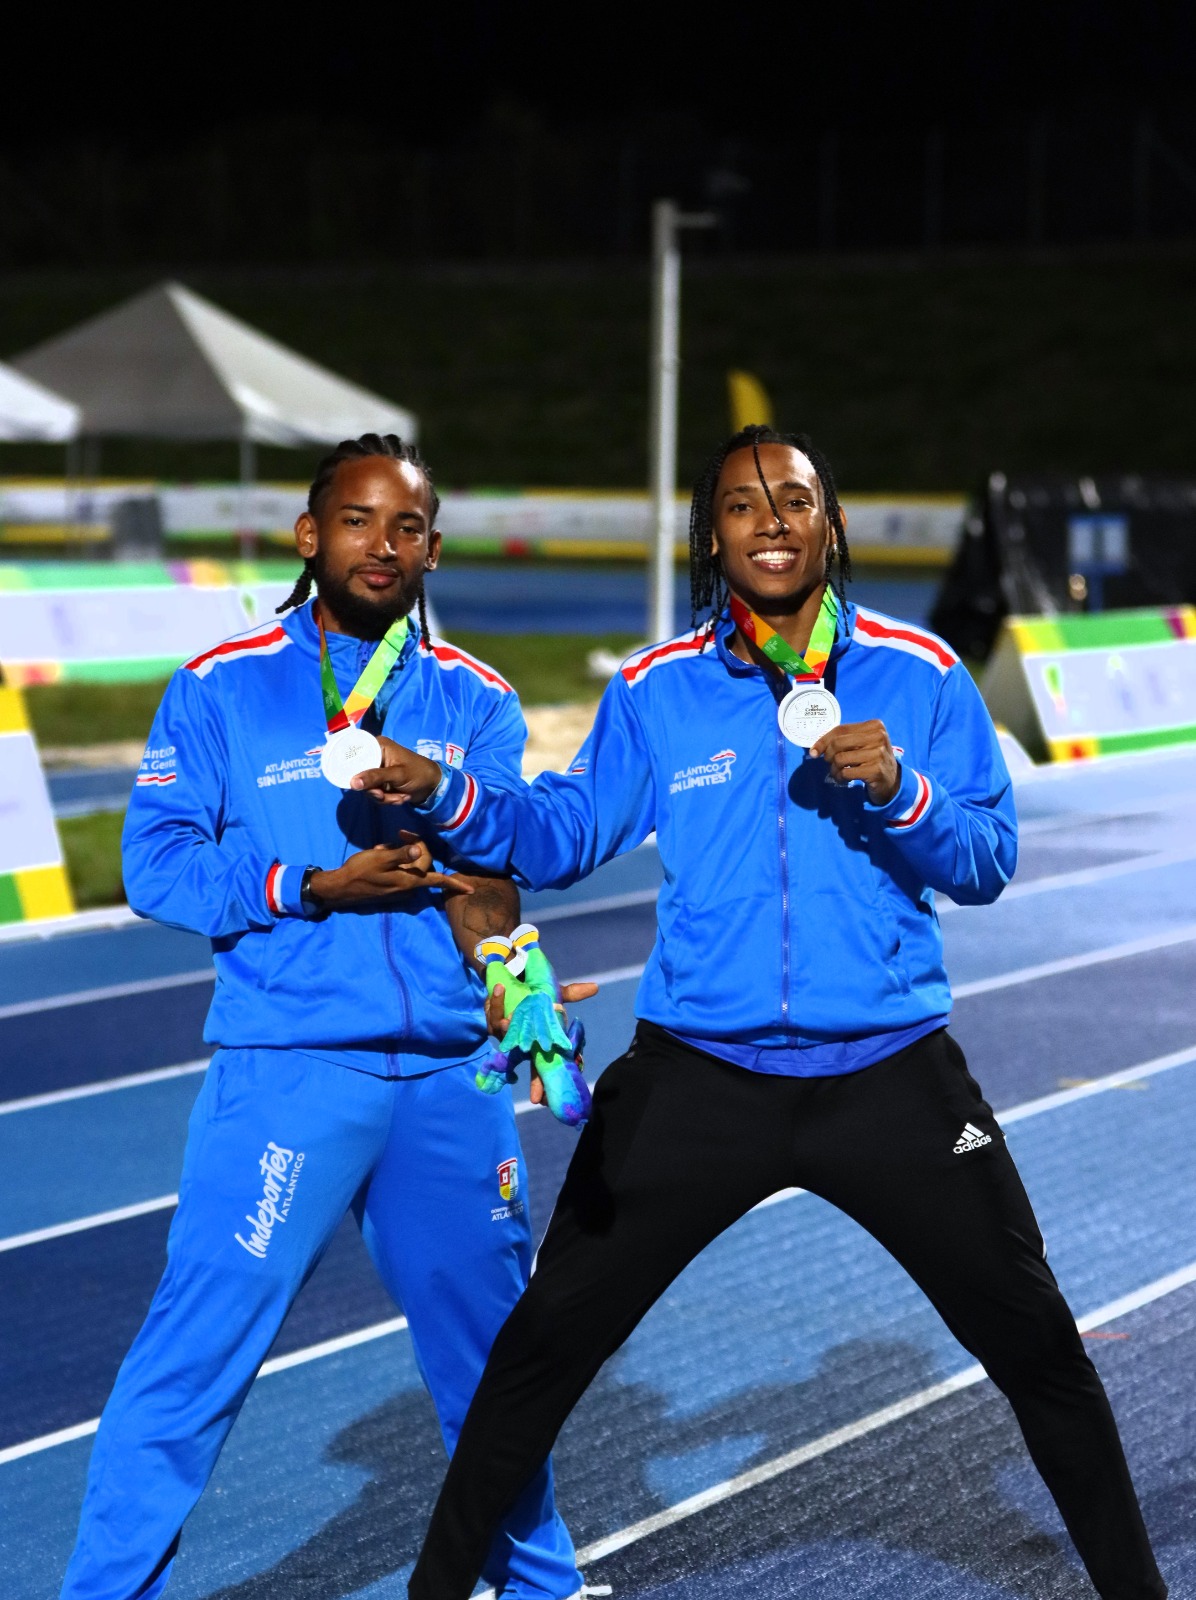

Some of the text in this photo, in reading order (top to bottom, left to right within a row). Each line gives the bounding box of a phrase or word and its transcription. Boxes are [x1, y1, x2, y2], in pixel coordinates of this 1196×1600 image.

[265, 757, 314, 774] ATLÁNTICO
[674, 763, 719, 781] ATLÁNTICO
[257, 767, 321, 788] SIN LÍMITES
[682, 773, 727, 790] LÍMITES
[953, 1134, 992, 1154] adidas
[281, 1153, 305, 1217] ATLÁNTICO
[234, 1141, 294, 1259] Indeportes
